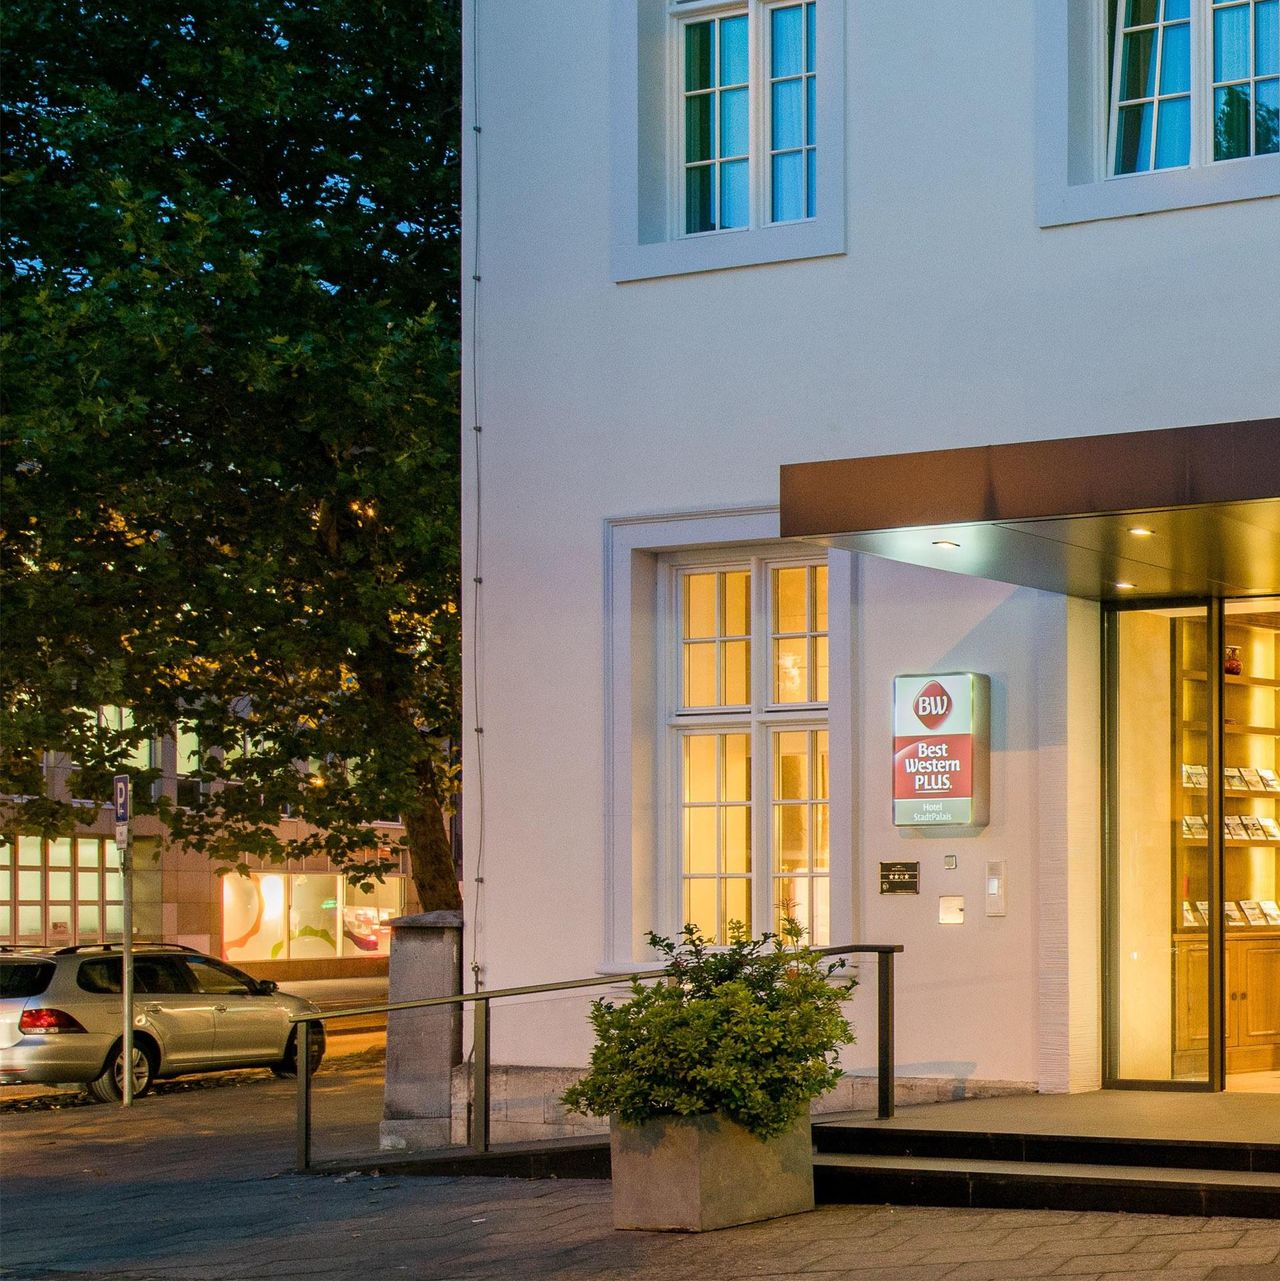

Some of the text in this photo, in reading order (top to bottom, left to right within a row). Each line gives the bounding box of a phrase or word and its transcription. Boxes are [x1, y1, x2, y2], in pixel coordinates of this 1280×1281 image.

[918, 695, 948, 716] BW
[918, 743, 949, 758] Best
[905, 758, 961, 773] Western
[922, 802, 943, 811] Hotel
[913, 812, 953, 821] StadtPalais
